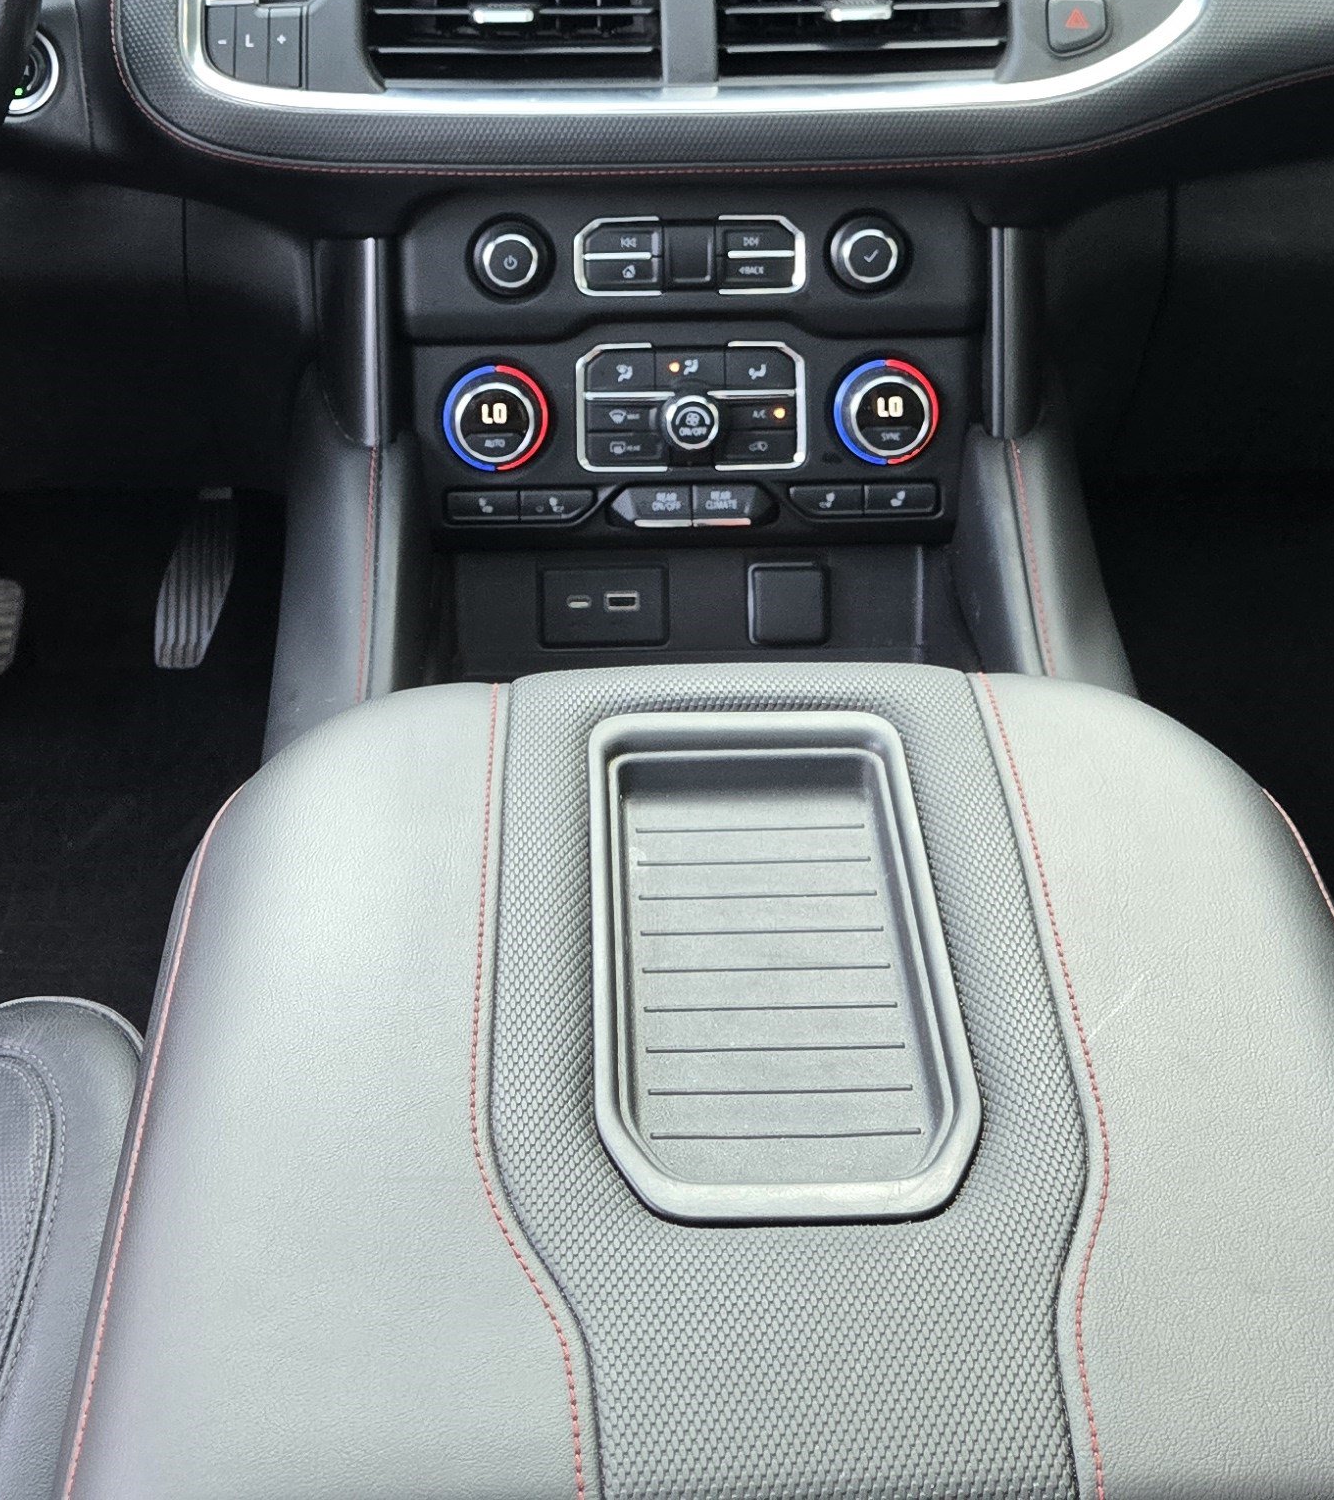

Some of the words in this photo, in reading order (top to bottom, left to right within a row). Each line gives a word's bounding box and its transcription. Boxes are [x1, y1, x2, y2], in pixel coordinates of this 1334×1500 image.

[245, 34, 255, 48] L
[745, 266, 764, 275] BACK
[877, 396, 903, 418] LO
[481, 402, 508, 425] LO
[679, 426, 707, 436] ON/OFF
[880, 432, 901, 442] SYNC
[485, 438, 506, 448] AUTO
[655, 492, 677, 501] REAR
[710, 490, 731, 500] REAR
[651, 500, 682, 512] ON/OFF
[705, 500, 737, 510] CLIMATE
